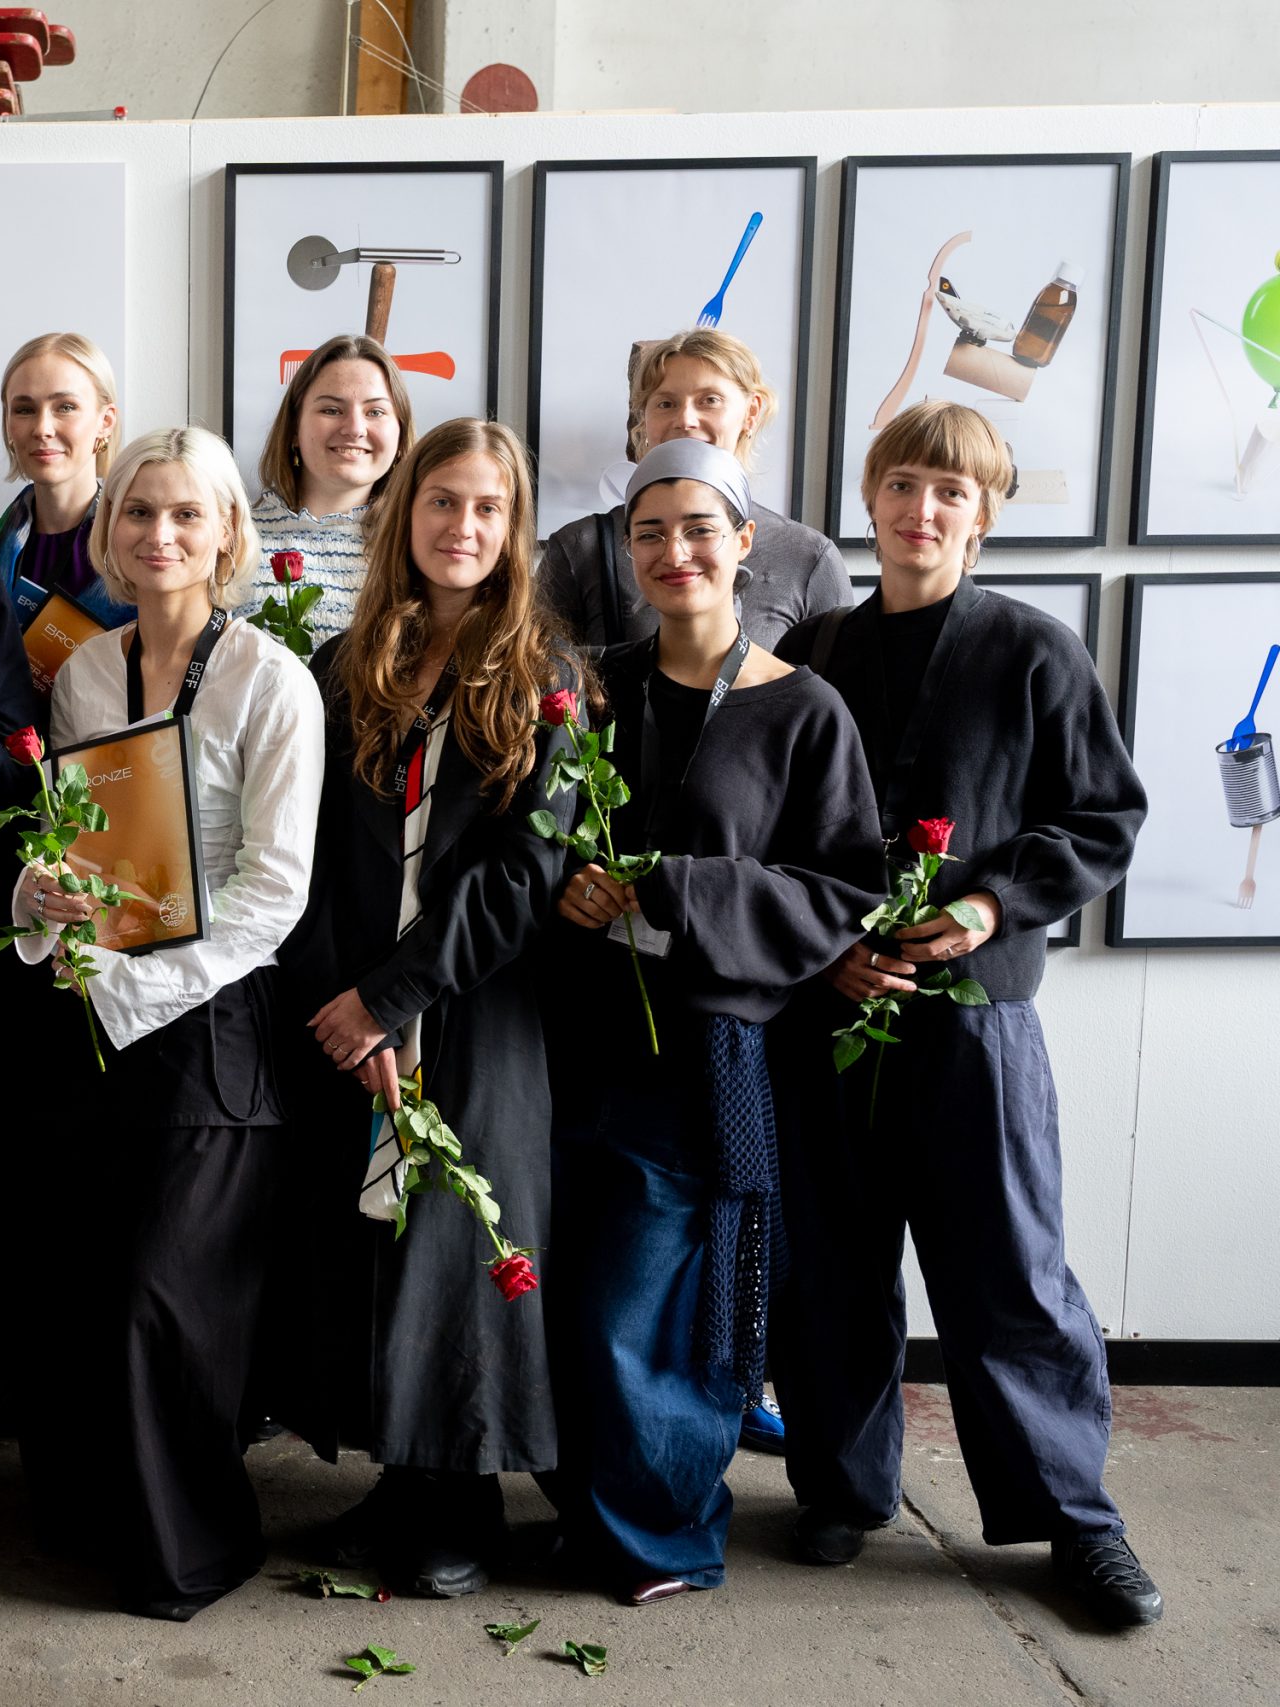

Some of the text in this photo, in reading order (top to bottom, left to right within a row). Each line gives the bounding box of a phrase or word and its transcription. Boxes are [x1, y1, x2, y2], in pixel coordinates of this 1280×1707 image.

[213, 608, 226, 632] BFF
[186, 661, 205, 689] BFF
[711, 677, 729, 707] BFF
[86, 766, 133, 788] RONZE
